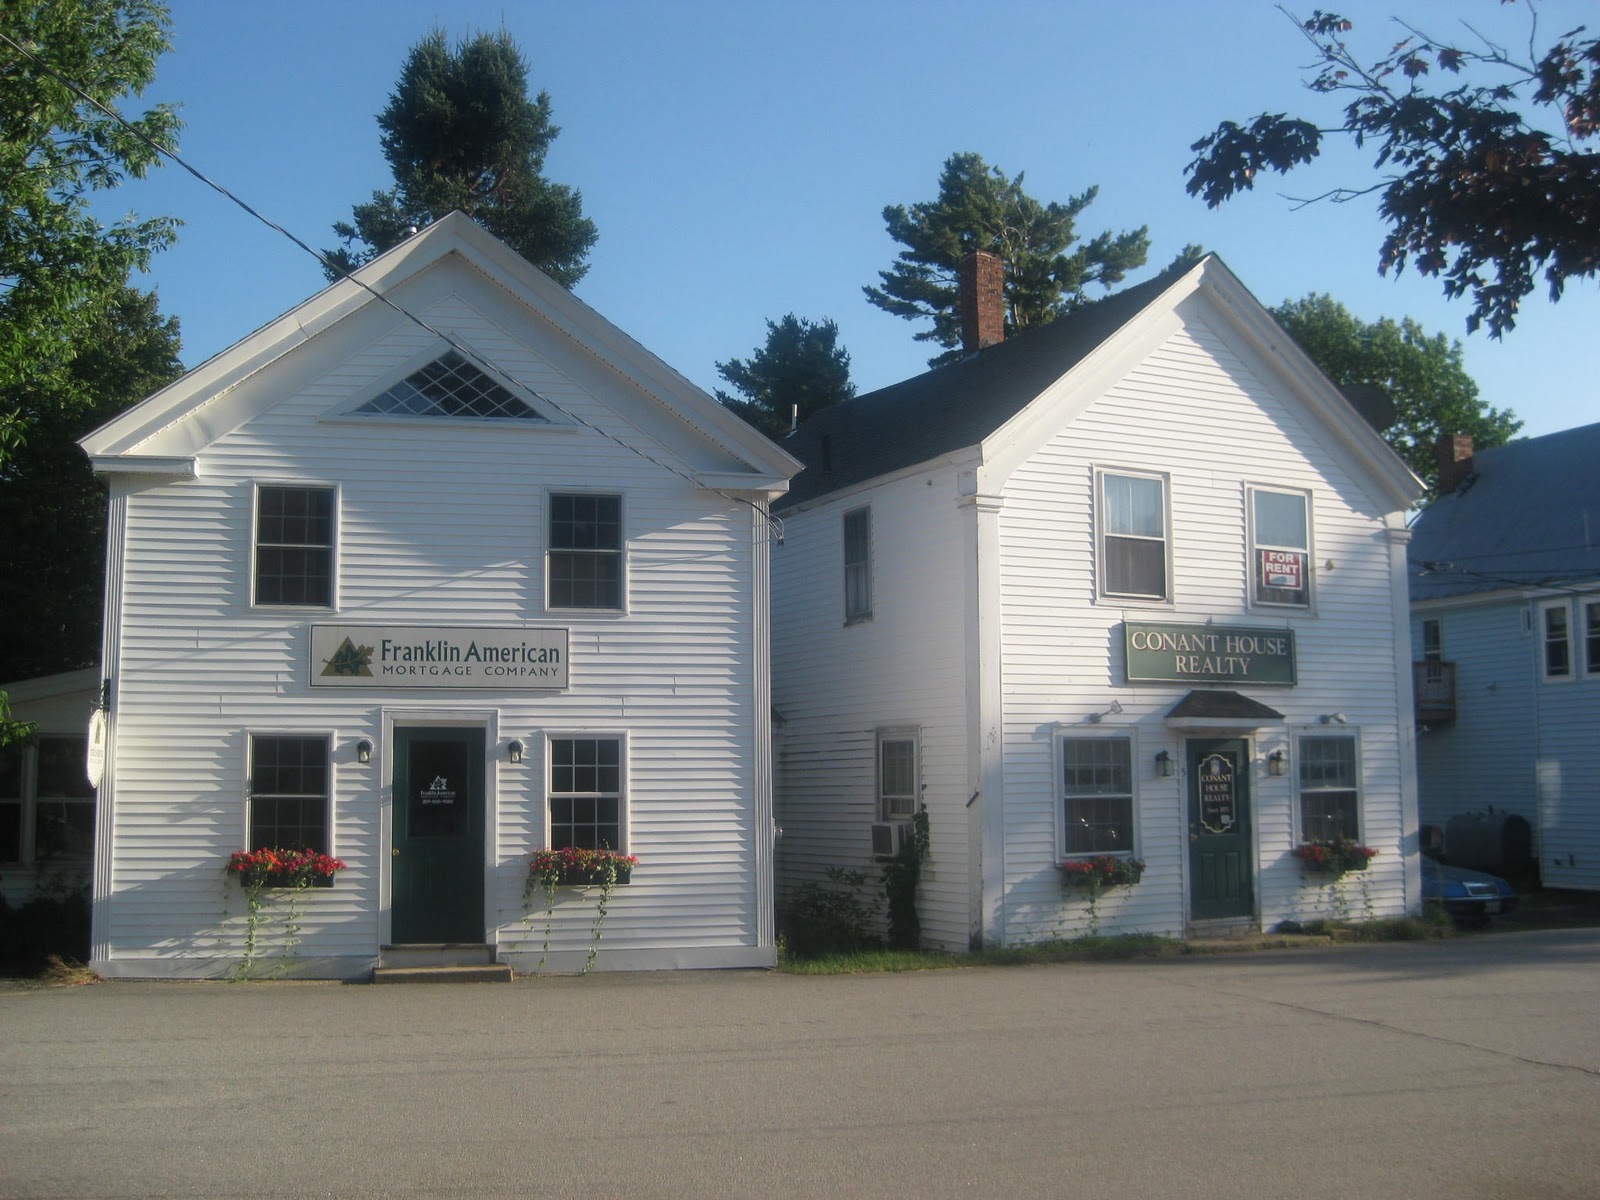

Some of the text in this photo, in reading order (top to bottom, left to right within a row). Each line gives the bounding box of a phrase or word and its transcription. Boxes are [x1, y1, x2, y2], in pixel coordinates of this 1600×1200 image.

[1269, 552, 1294, 563] FOR
[1265, 562, 1299, 574] RENT
[1131, 631, 1287, 656] CONANT HOUSE
[381, 639, 560, 663] Franklin American
[382, 665, 559, 677] MORTGAGE COMPANY
[1175, 655, 1250, 675] REALTY
[1201, 774, 1232, 782] CONANT
[1205, 784, 1228, 792] HOUSE
[1203, 794, 1230, 802] REALTY
